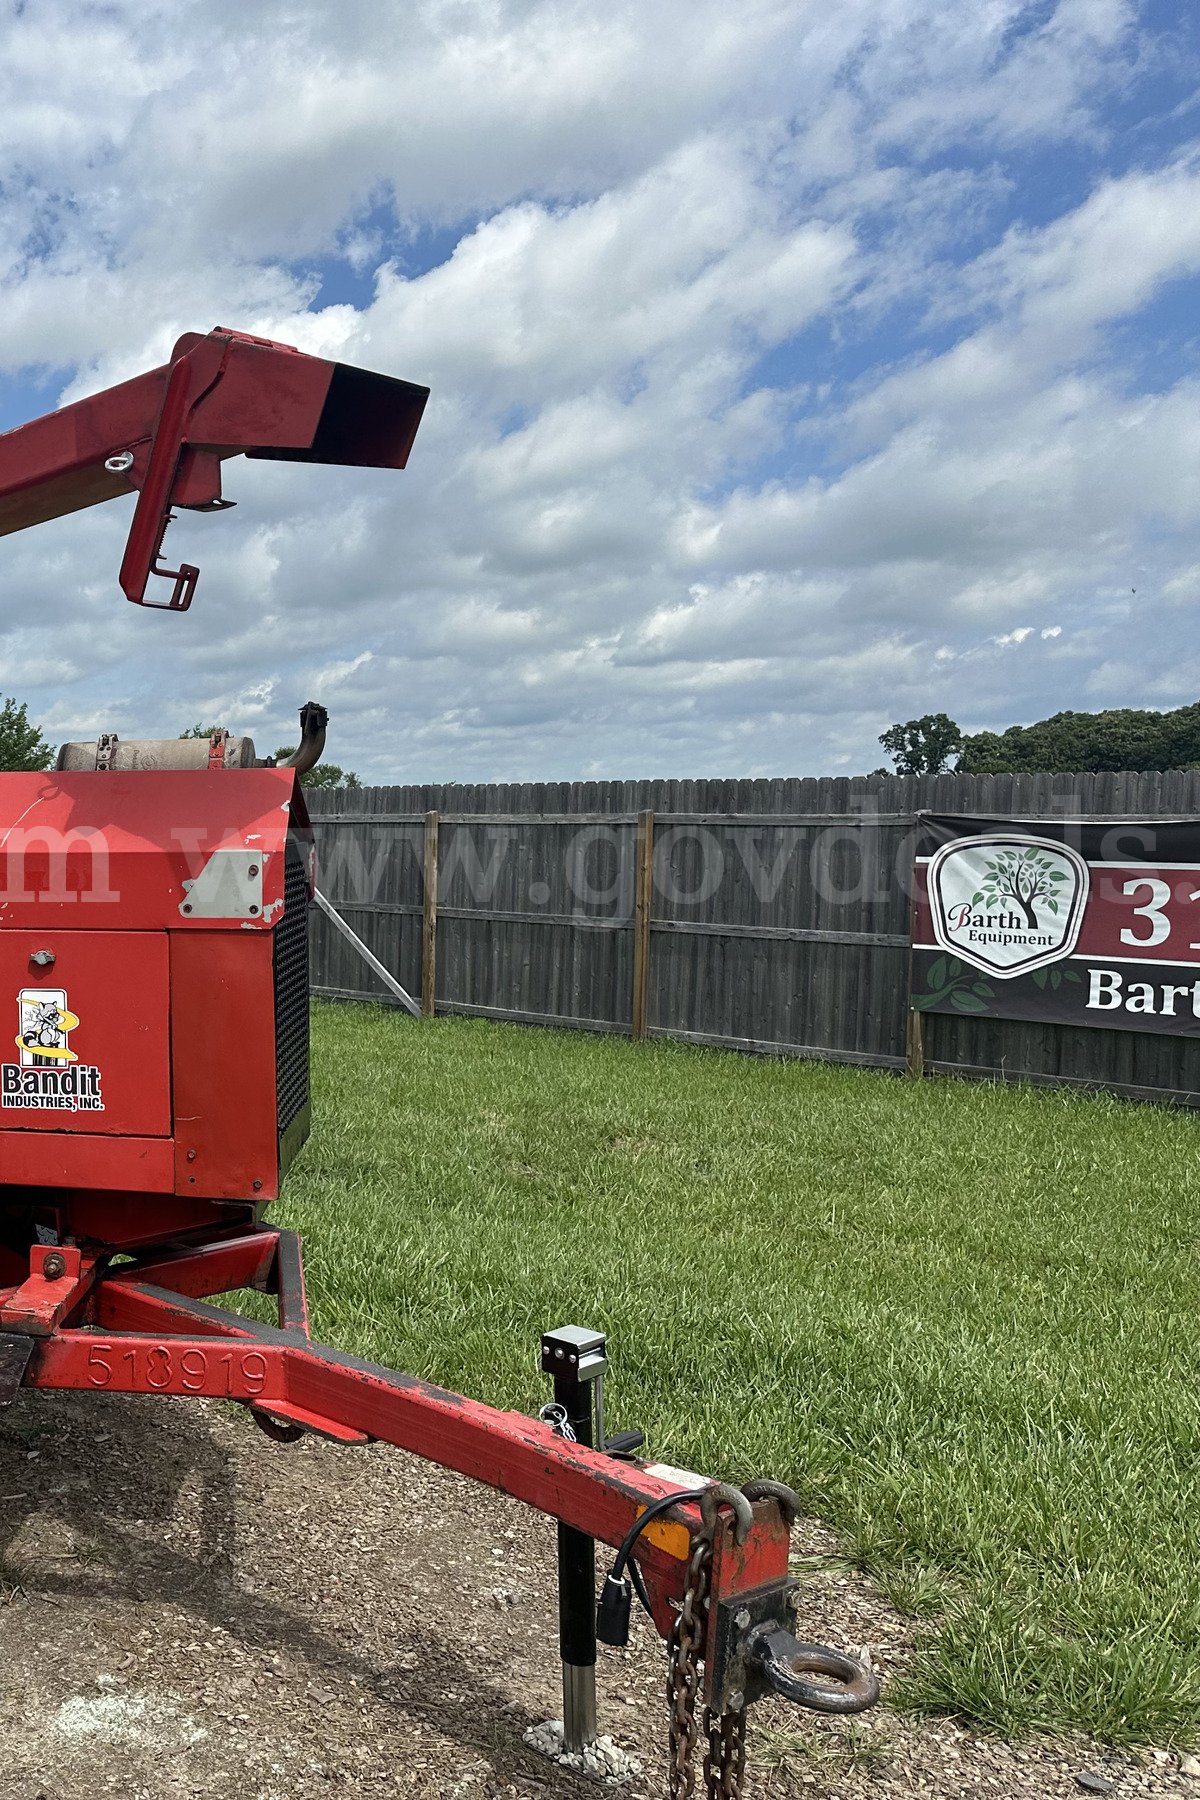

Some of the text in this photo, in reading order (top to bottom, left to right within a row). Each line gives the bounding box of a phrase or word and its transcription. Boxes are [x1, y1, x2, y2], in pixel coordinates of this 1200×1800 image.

[948, 903, 1022, 932] Barth
[1120, 878, 1200, 949] 3
[969, 930, 1053, 946] Equipment
[2, 1065, 100, 1096] Bandit
[3, 1096, 104, 1110] INDUSTRIES, INC.
[87, 1344, 268, 1394] 518919
